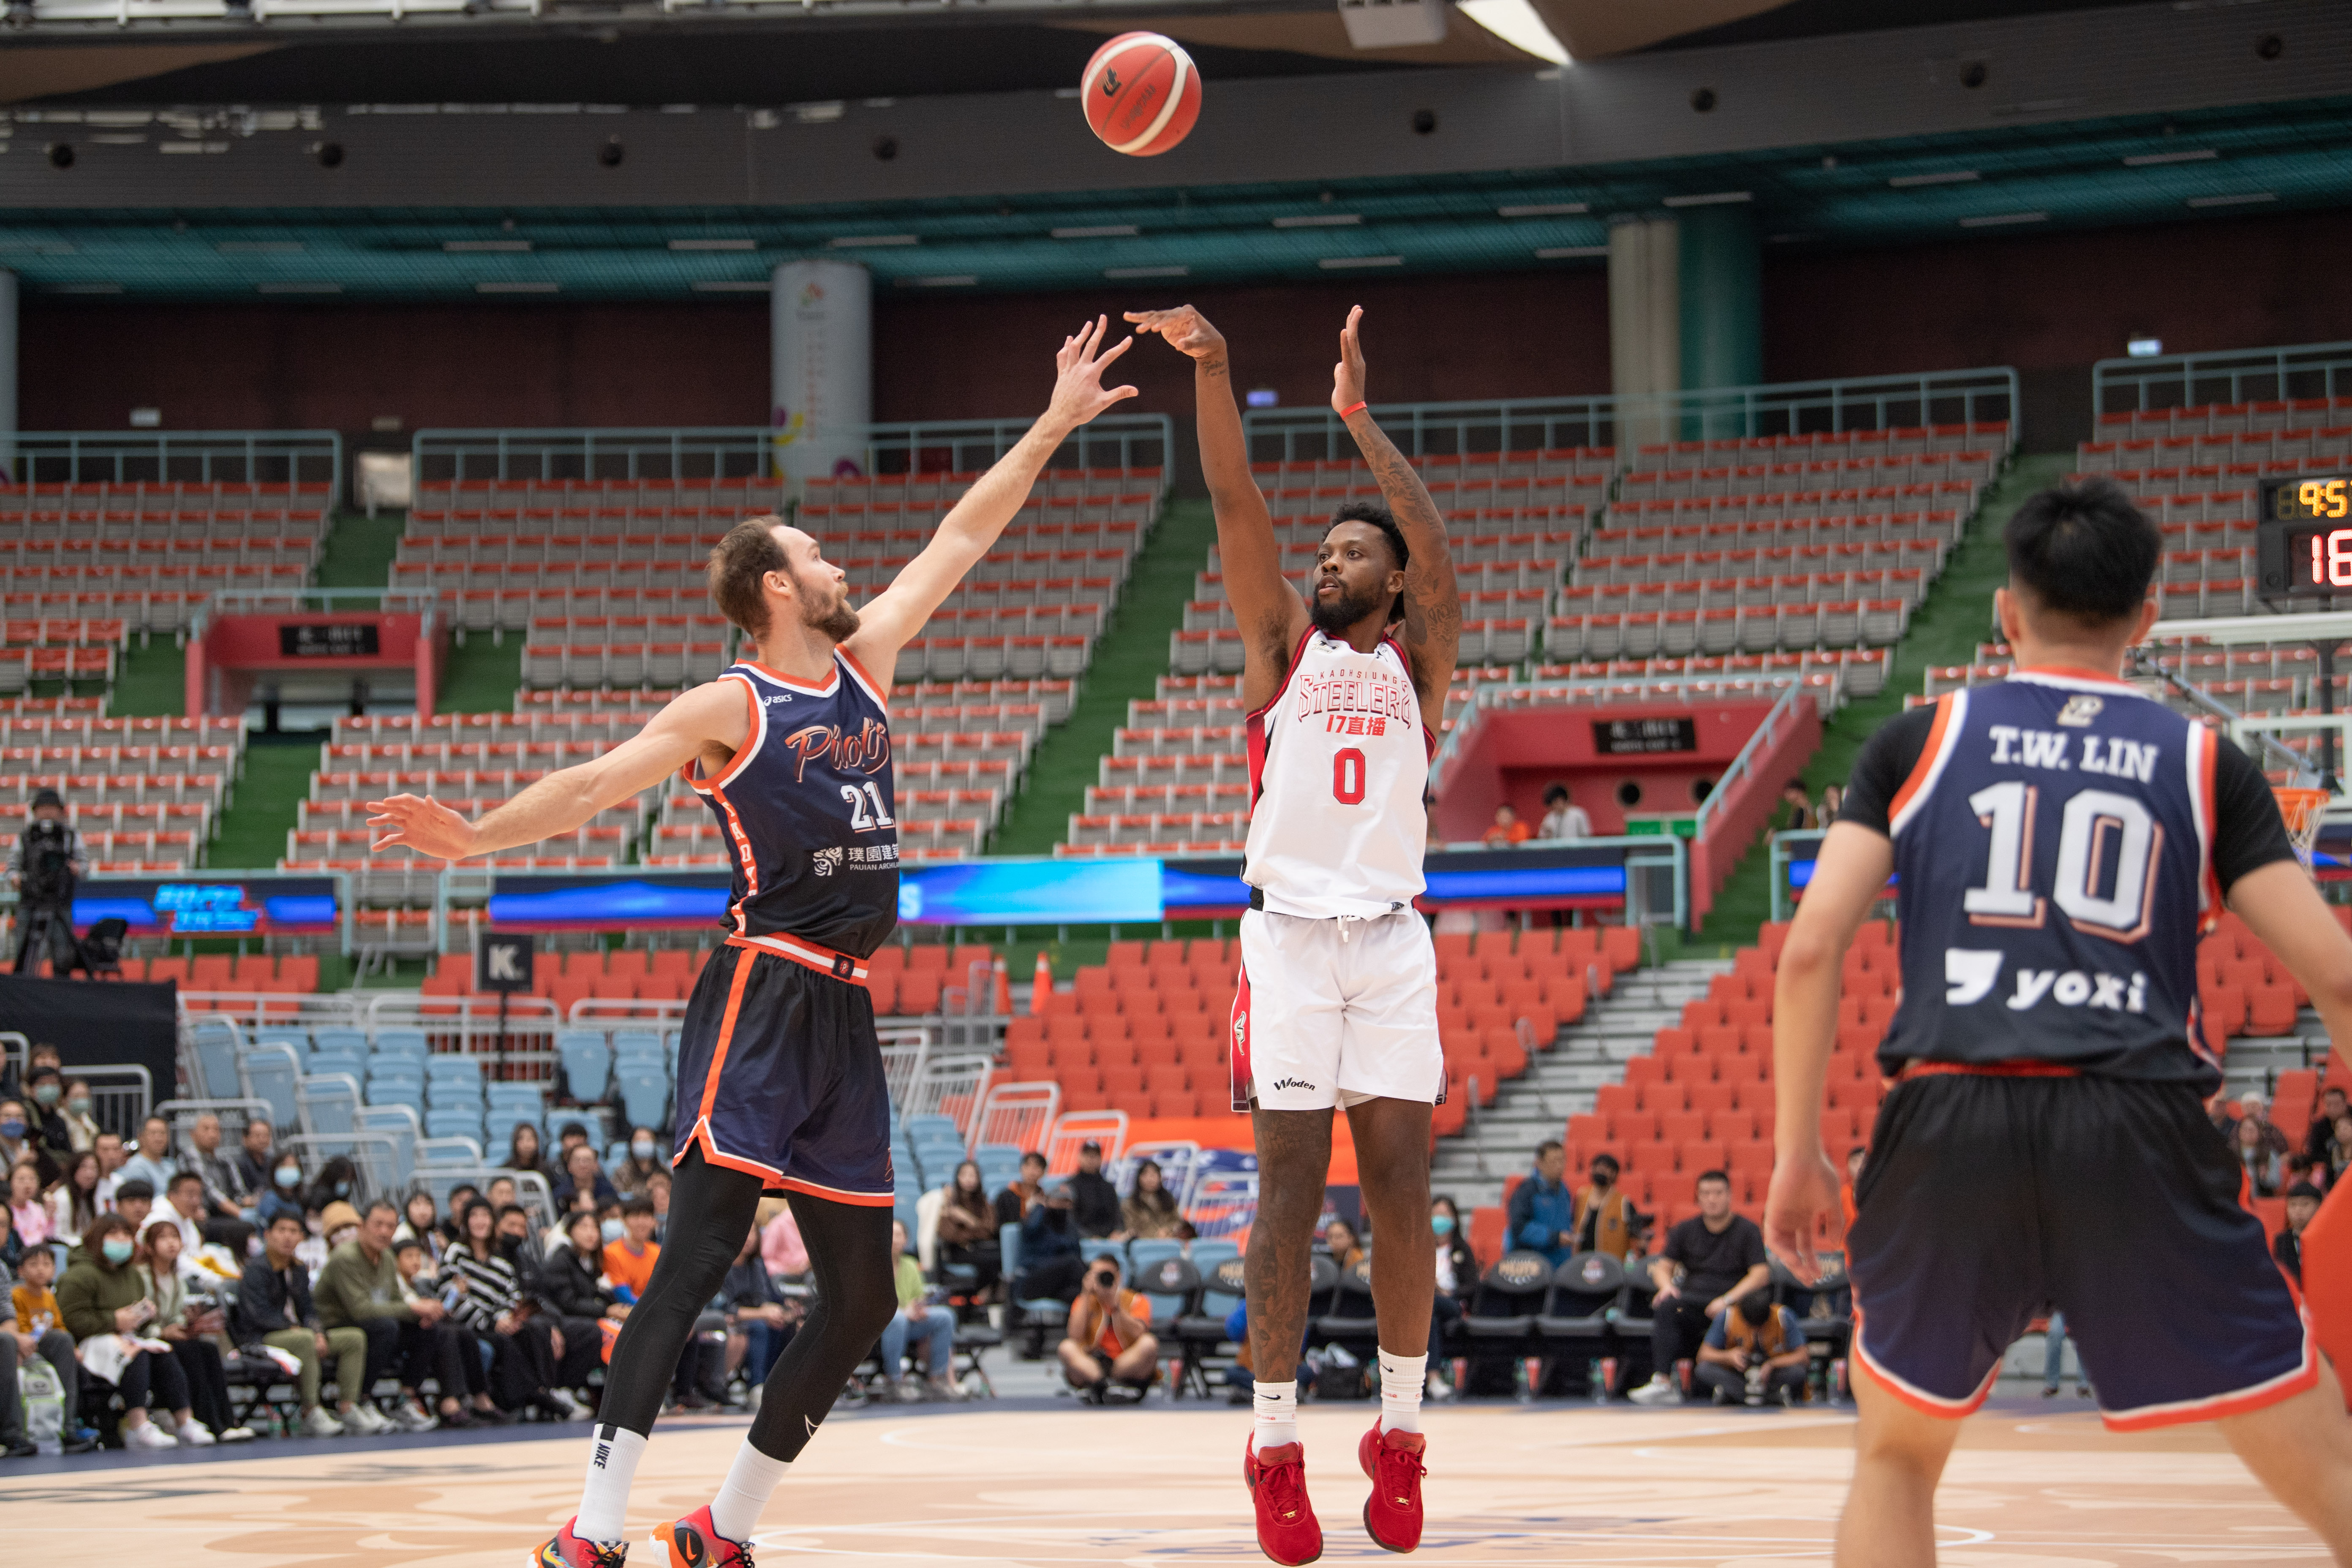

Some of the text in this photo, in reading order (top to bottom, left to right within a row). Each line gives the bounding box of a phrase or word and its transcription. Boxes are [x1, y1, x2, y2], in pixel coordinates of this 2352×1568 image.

[1320, 669, 1397, 684] KAOHSIUNG
[773, 694, 792, 703] asics
[1298, 675, 1412, 730] STEELERS
[1326, 714, 1386, 737] 17直播
[784, 717, 890, 783] Pilots
[1989, 725, 2159, 783] T.W. LIN
[1334, 747, 1365, 805] 0
[840, 781, 896, 833] 21
[1963, 781, 2165, 945] 10
[489, 945, 517, 979] K
[841, 963, 847, 972] P
[2006, 968, 2148, 1012] yoxi
[1274, 1077, 1315, 1091] Woden
[594, 1443, 610, 1469] NIKE
